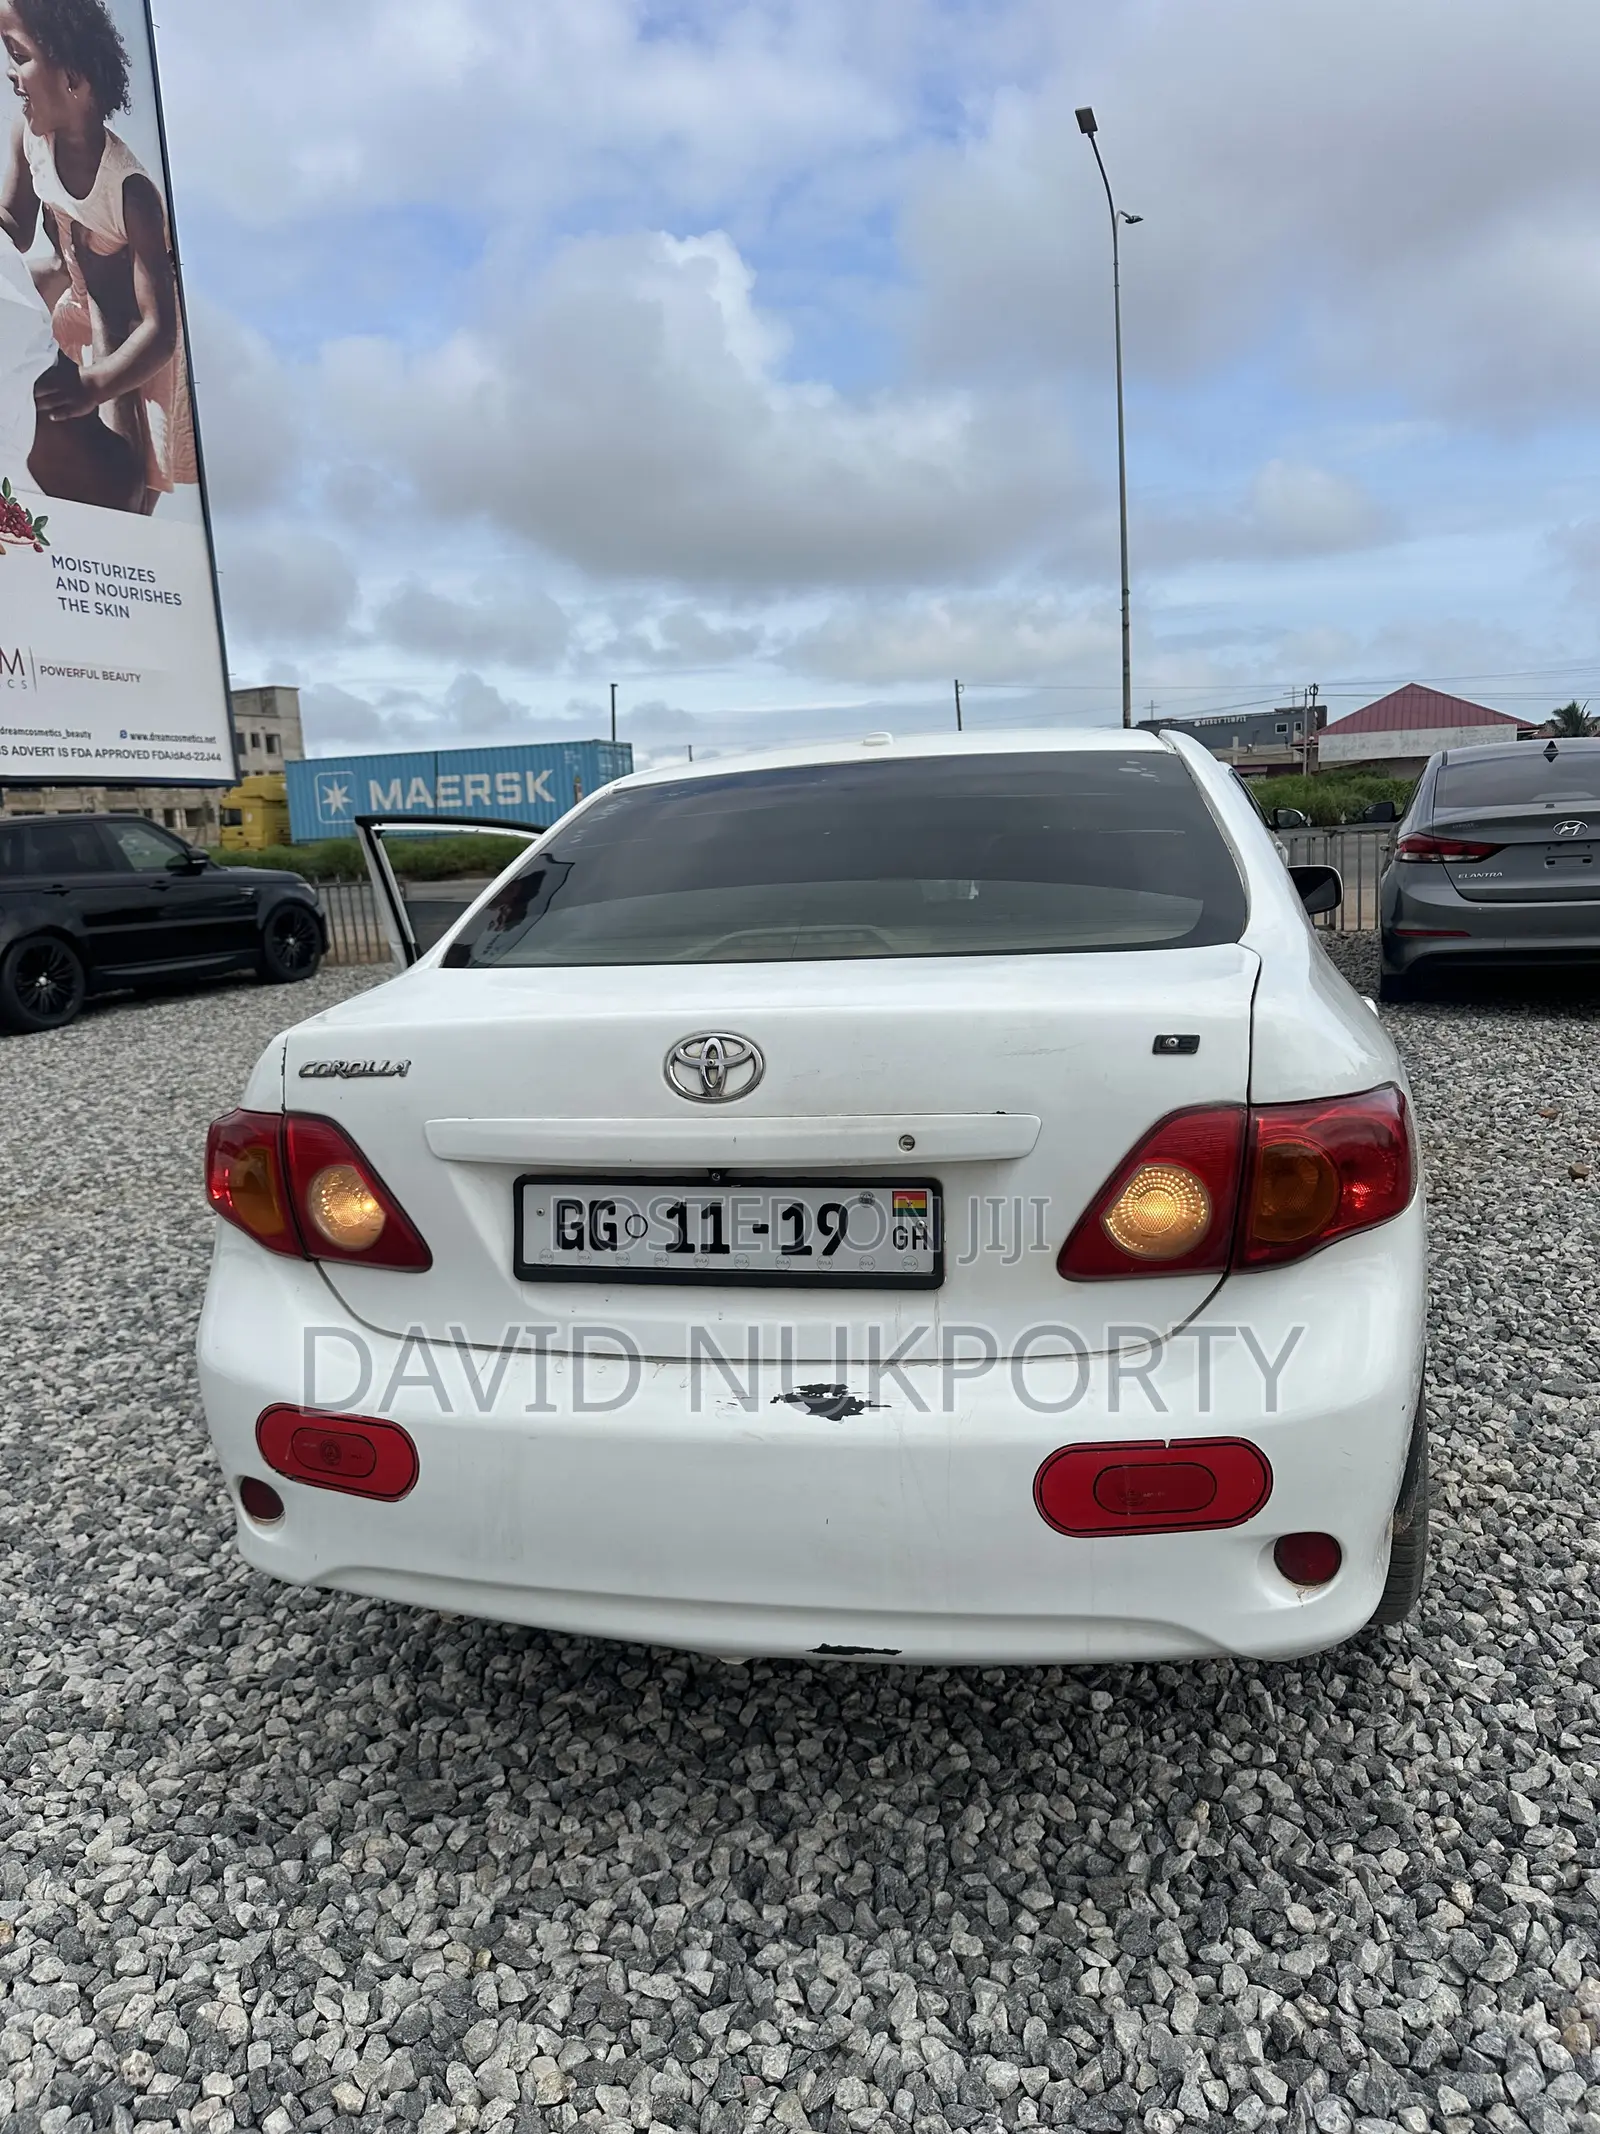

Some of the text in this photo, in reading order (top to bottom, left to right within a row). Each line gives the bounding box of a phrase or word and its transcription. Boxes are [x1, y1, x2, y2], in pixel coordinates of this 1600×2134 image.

[51, 555, 156, 583] MOISTURIZES
[56, 577, 182, 606] AND NOURISHES
[58, 597, 130, 619] THE SKIN
[40, 665, 141, 683] POWERFUL BEAUTY
[130, 732, 216, 744] www.dreamcosmetics.net
[12, 746, 55, 757] ADVERT
[58, 748, 69, 758] IS
[71, 748, 93, 759] FDA
[95, 749, 150, 760] APPROVED
[369, 769, 556, 811] MAERSK
[1458, 871, 1503, 879] ELANTRA
[299, 1060, 411, 1078] COROLLA
[557, 1200, 618, 1251] GG
[892, 1226, 928, 1251] GH
